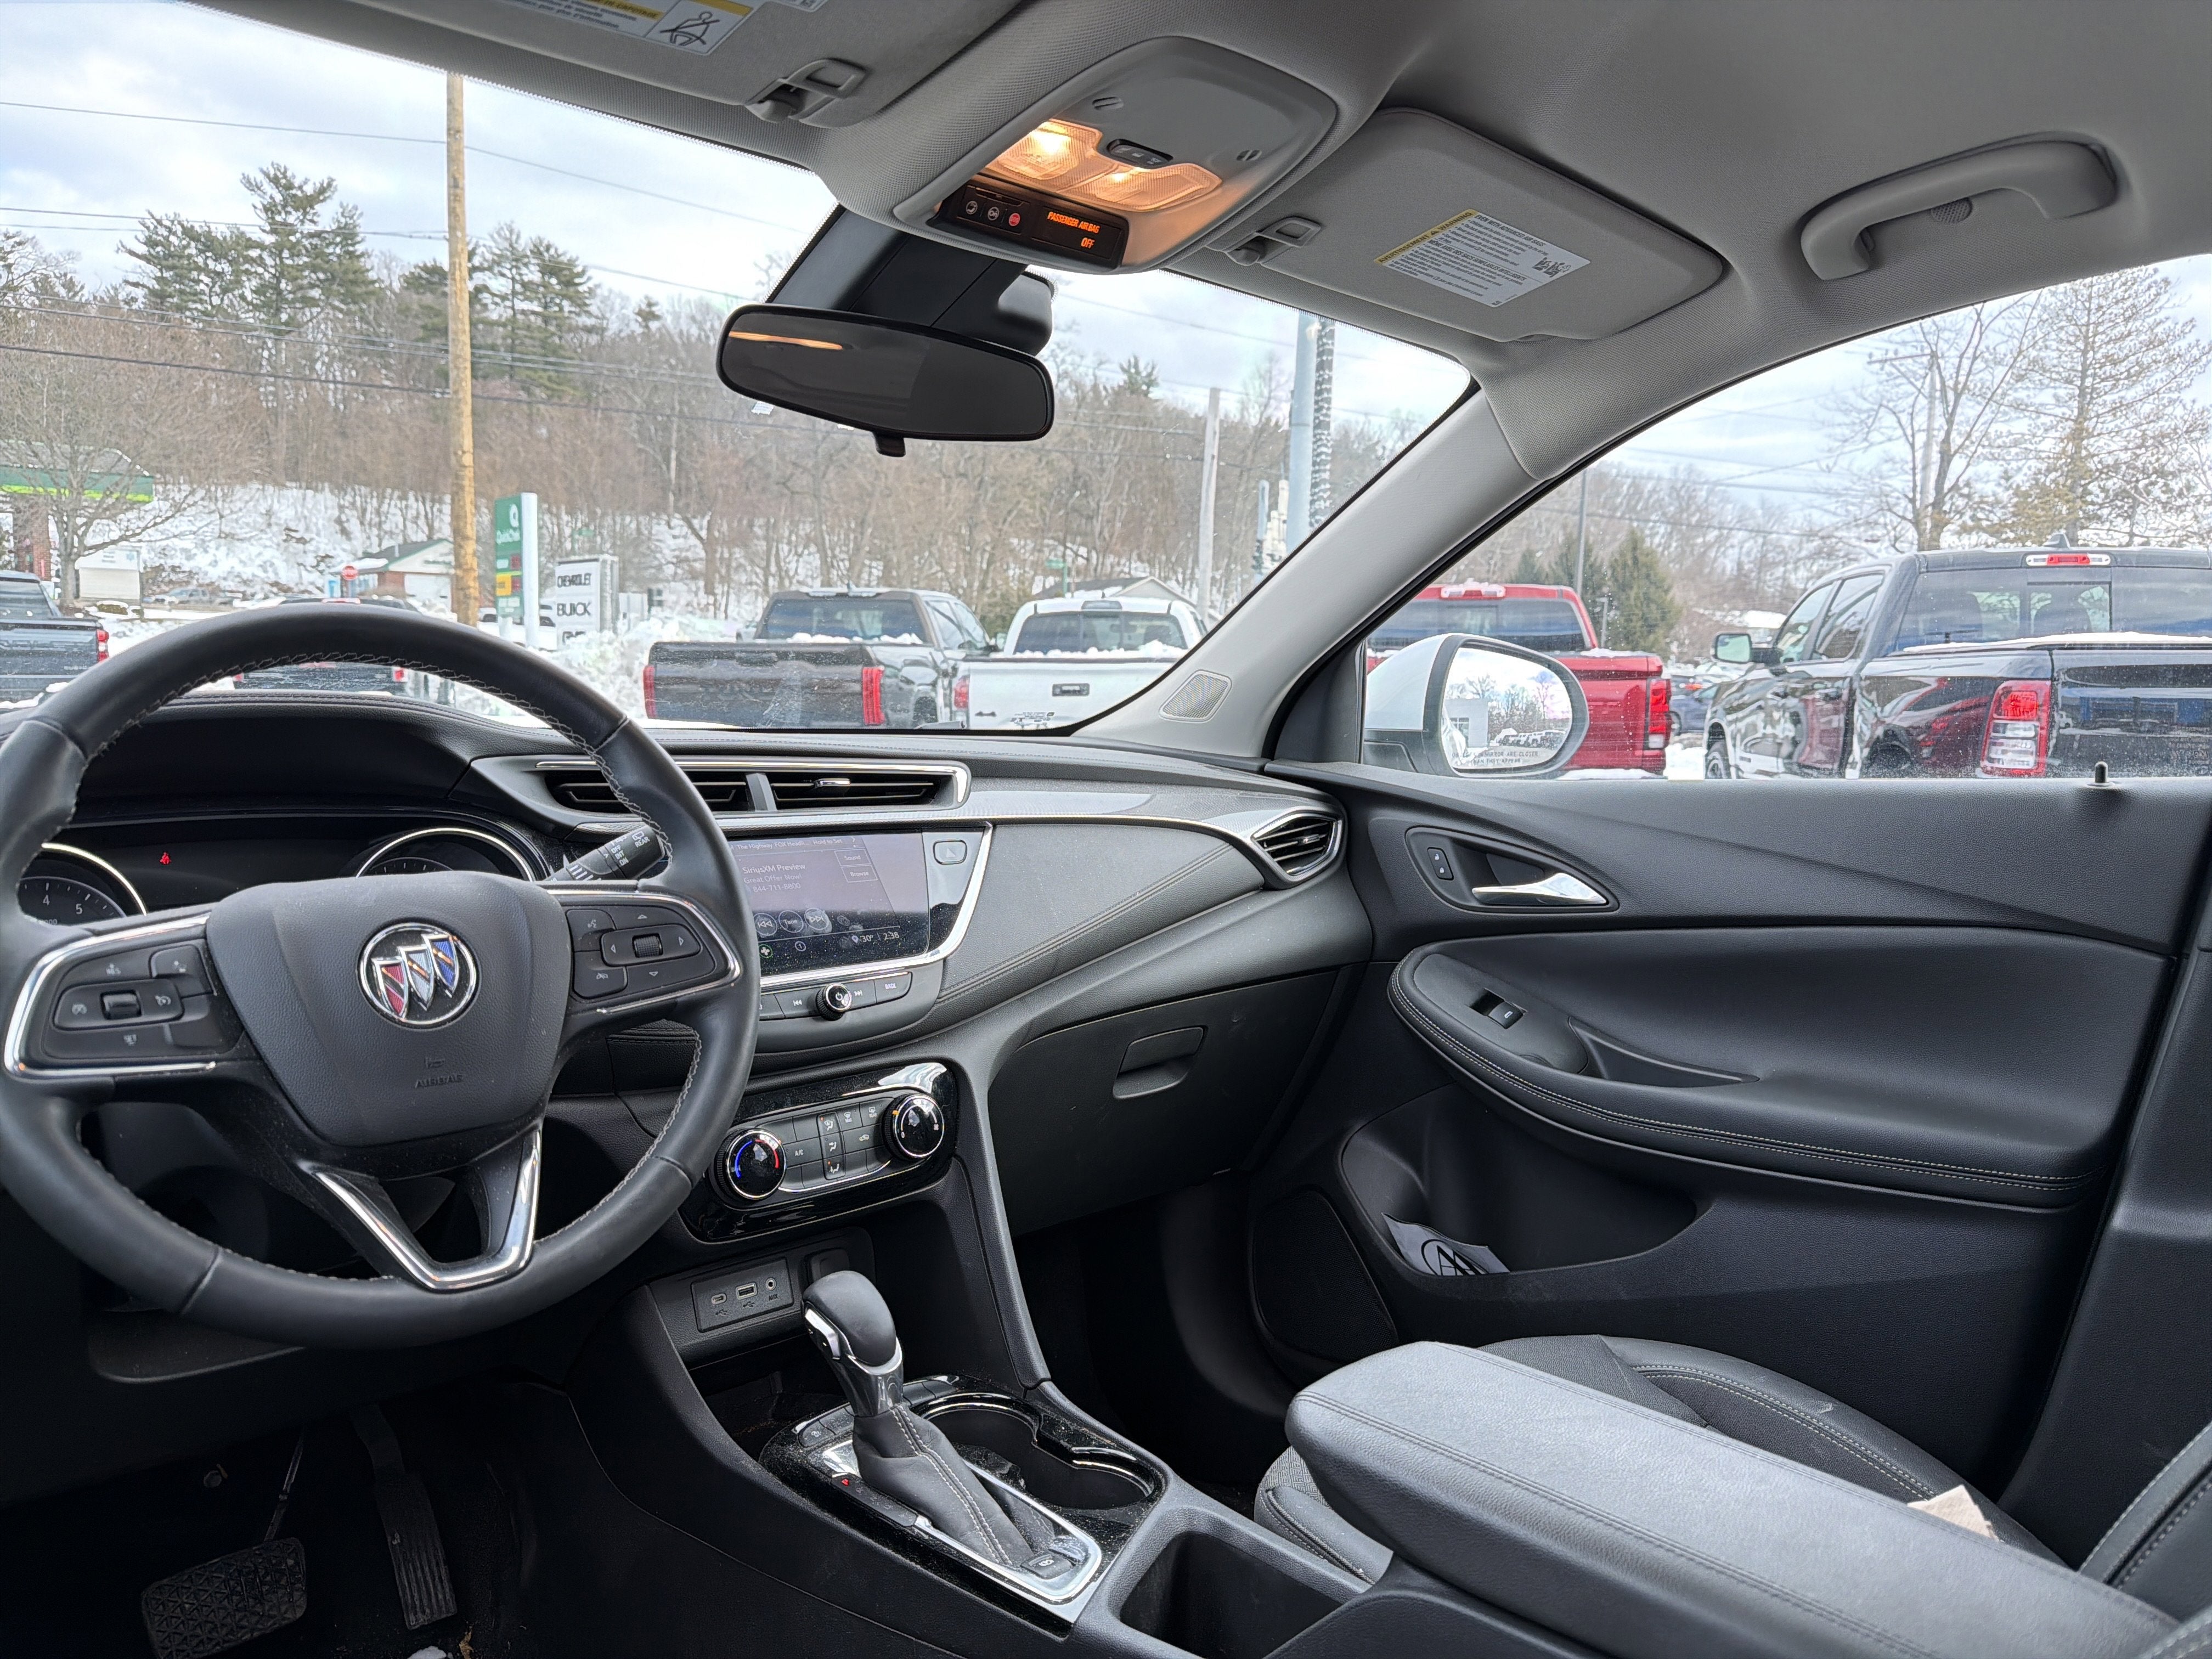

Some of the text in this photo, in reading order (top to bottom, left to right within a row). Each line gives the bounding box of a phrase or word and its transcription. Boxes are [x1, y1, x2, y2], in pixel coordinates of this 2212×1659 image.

[1047, 211, 1079, 228] PASSENGER
[1473, 214, 1491, 222] EVEN
[1485, 219, 1503, 228] WITH
[1081, 237, 1095, 249] OFF
[1378, 234, 1430, 263] AVERTISSEMENT
[1438, 212, 1472, 230] WARNING
[557, 601, 591, 616] BUICK
[635, 836, 651, 848] REAR
[611, 845, 622, 854] OFF
[619, 857, 629, 866] ON
[742, 864, 806, 874] SiriusXM Preview
[43, 895, 50, 906] 4
[76, 904, 83, 915] 5
[883, 932, 900, 941] 2:38
